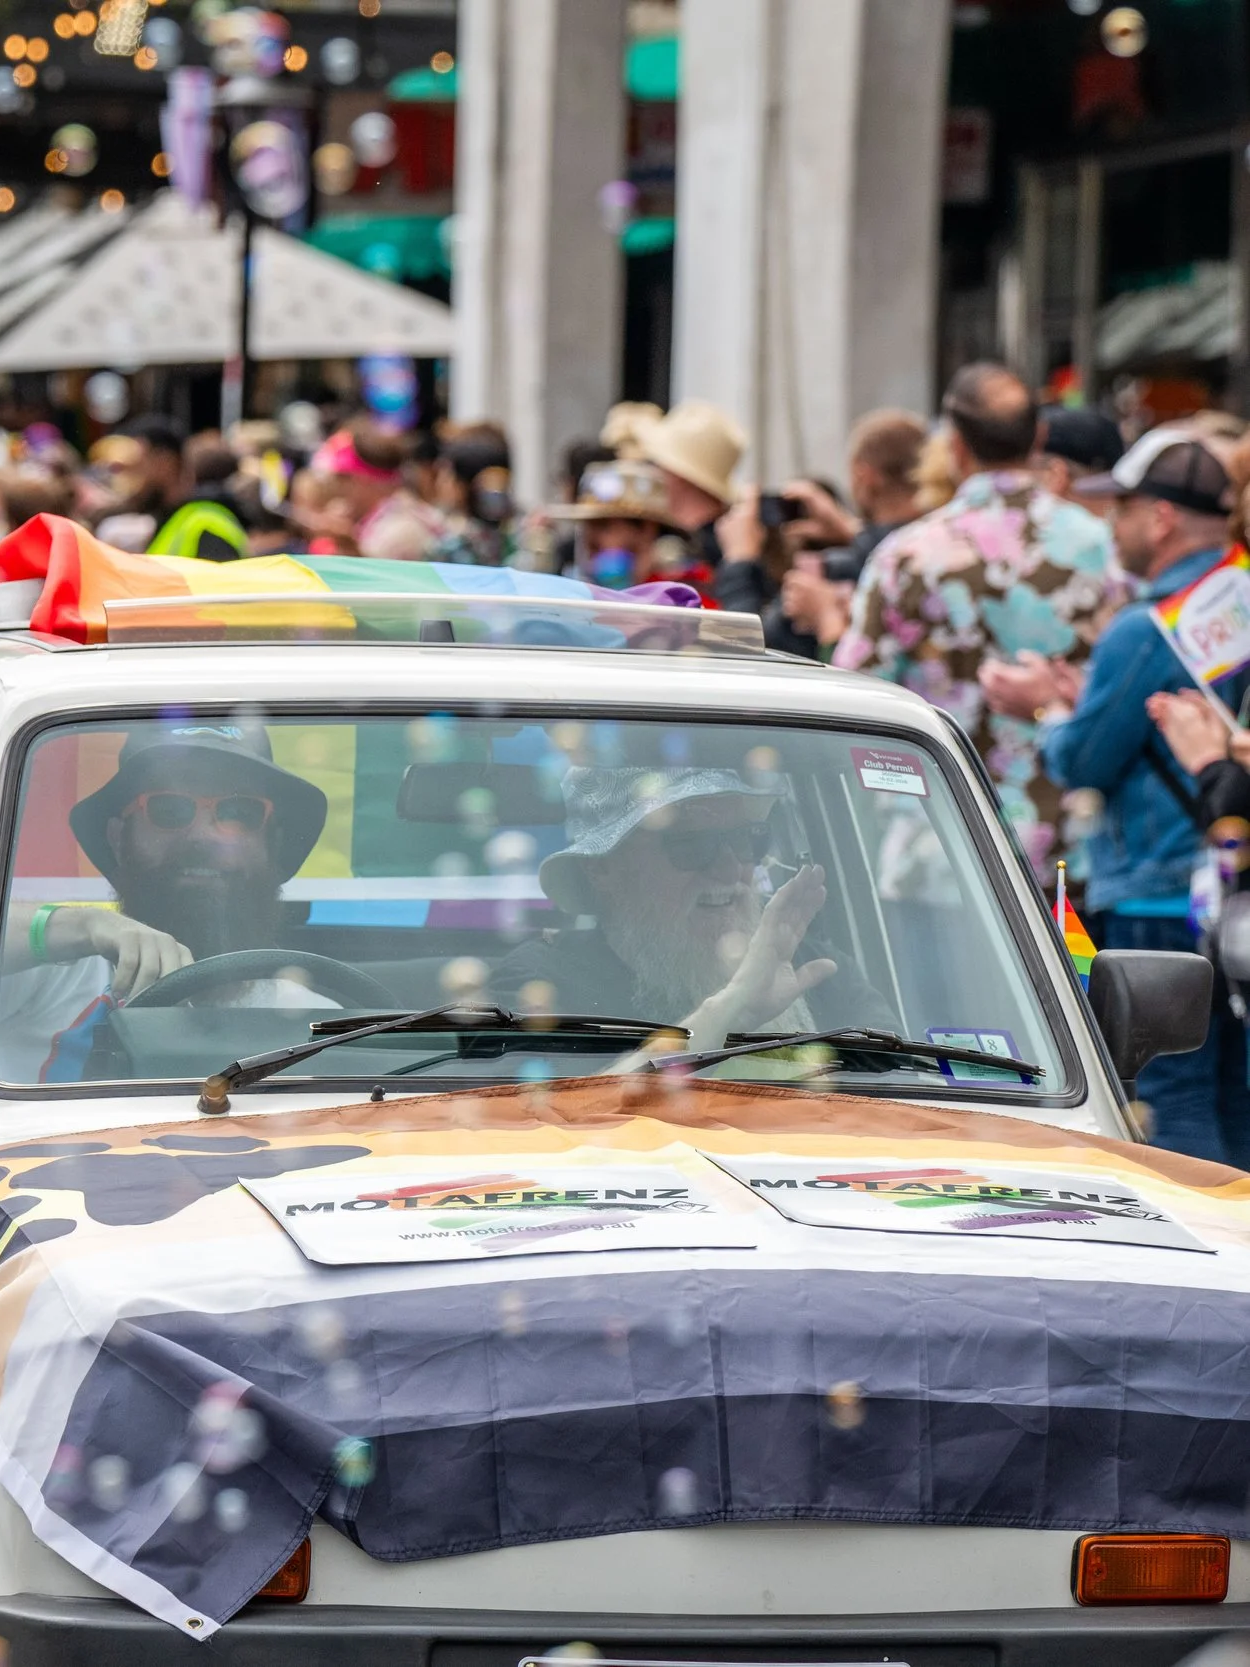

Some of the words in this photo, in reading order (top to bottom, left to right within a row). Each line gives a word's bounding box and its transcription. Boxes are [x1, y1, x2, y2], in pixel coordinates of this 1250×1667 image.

[863, 759, 884, 769] Club
[885, 762, 915, 774] Permit
[285, 1189, 688, 1217] MOTAFRENZ
[750, 1178, 1141, 1207] MOTAFRENZ
[399, 1220, 636, 1241] www.motafrenz.org.au
